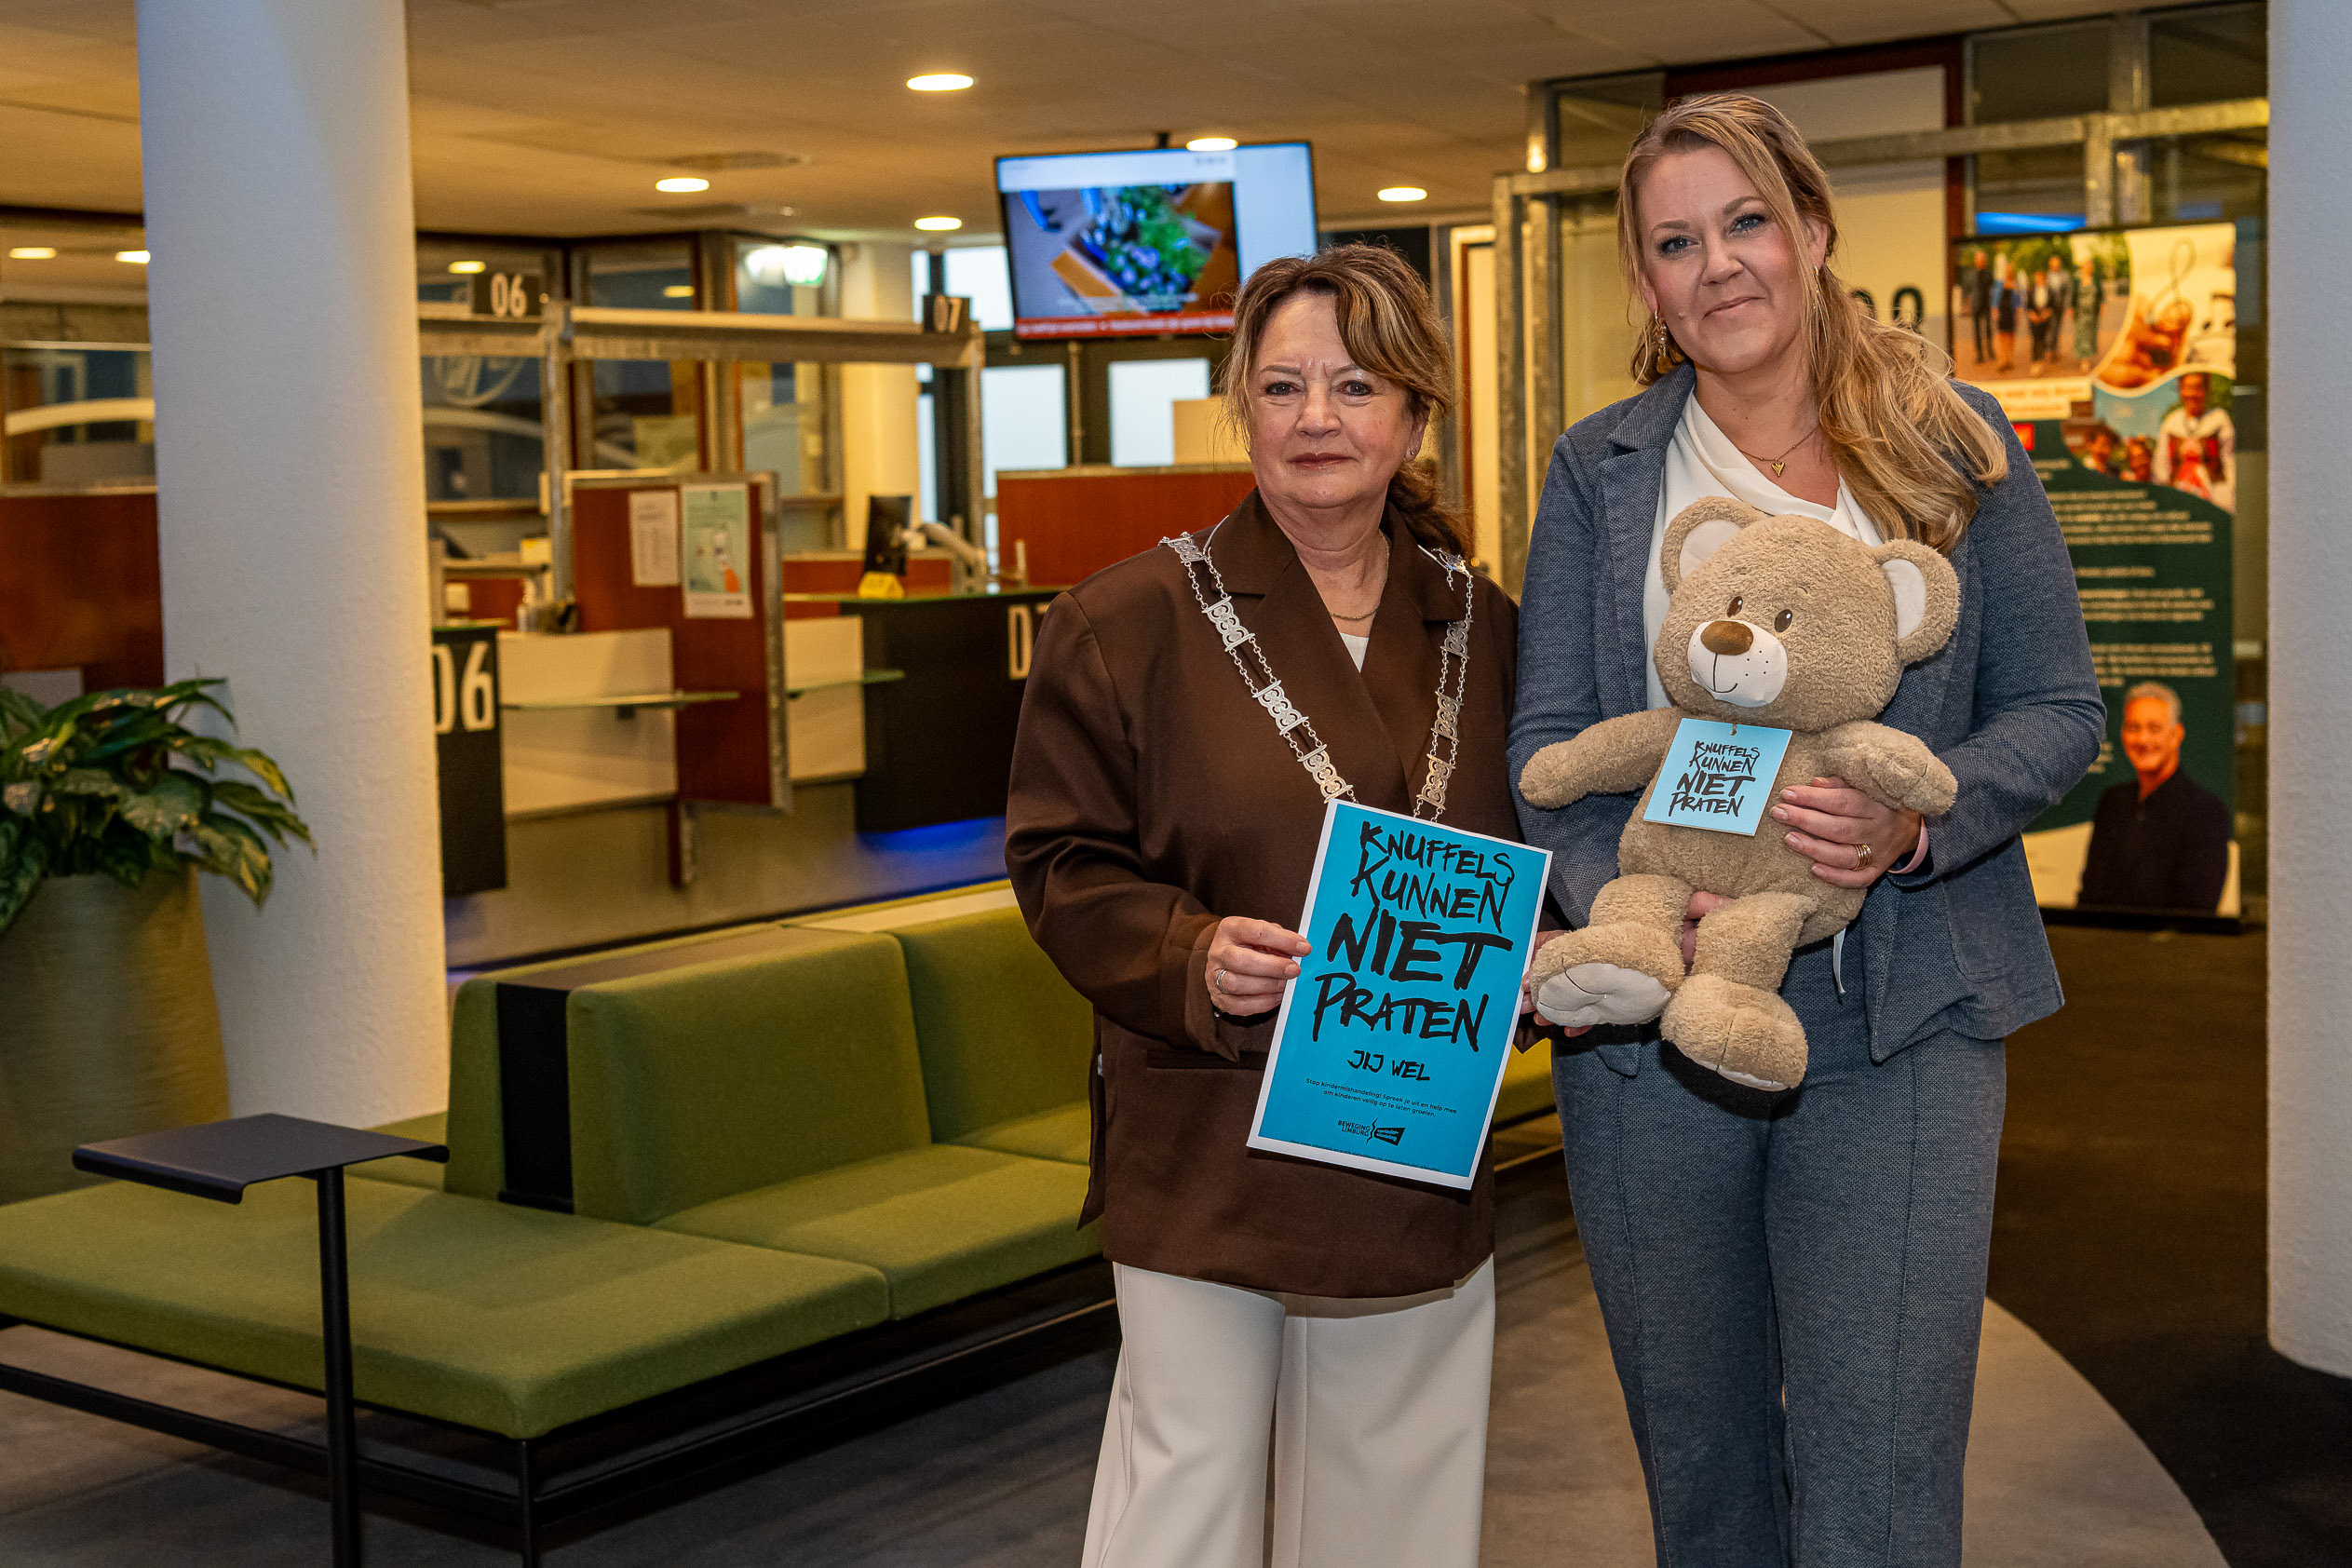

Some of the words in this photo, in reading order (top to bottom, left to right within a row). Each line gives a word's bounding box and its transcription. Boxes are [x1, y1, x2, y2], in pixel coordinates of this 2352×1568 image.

[491, 272, 527, 317] 06
[934, 294, 961, 333] 07
[431, 641, 495, 733] 06
[1689, 750, 1758, 776] KUNNEN
[1695, 740, 1760, 760] KNUFFELS
[1676, 769, 1756, 797] NIET
[1668, 791, 1744, 818] PRATEN
[1359, 820, 1516, 886] KNUFFELS
[1350, 848, 1510, 933] KUNNEN
[1327, 907, 1513, 991] NIET
[1312, 972, 1490, 1052] PRATEN
[1346, 1049, 1385, 1074] JIJ
[1391, 1060, 1430, 1082] WEL
[1305, 1077, 1320, 1087] Stop
[1321, 1081, 1383, 1099] kindermishandeling!
[1383, 1093, 1404, 1103] Spreek
[1429, 1103, 1443, 1112] help
[1334, 1092, 1361, 1102] kinderen
[1362, 1098, 1378, 1106] veilig
[1395, 1103, 1411, 1112] laten
[1337, 1119, 1371, 1131] BEWEGING
[1341, 1126, 1370, 1137] LIMBURG
